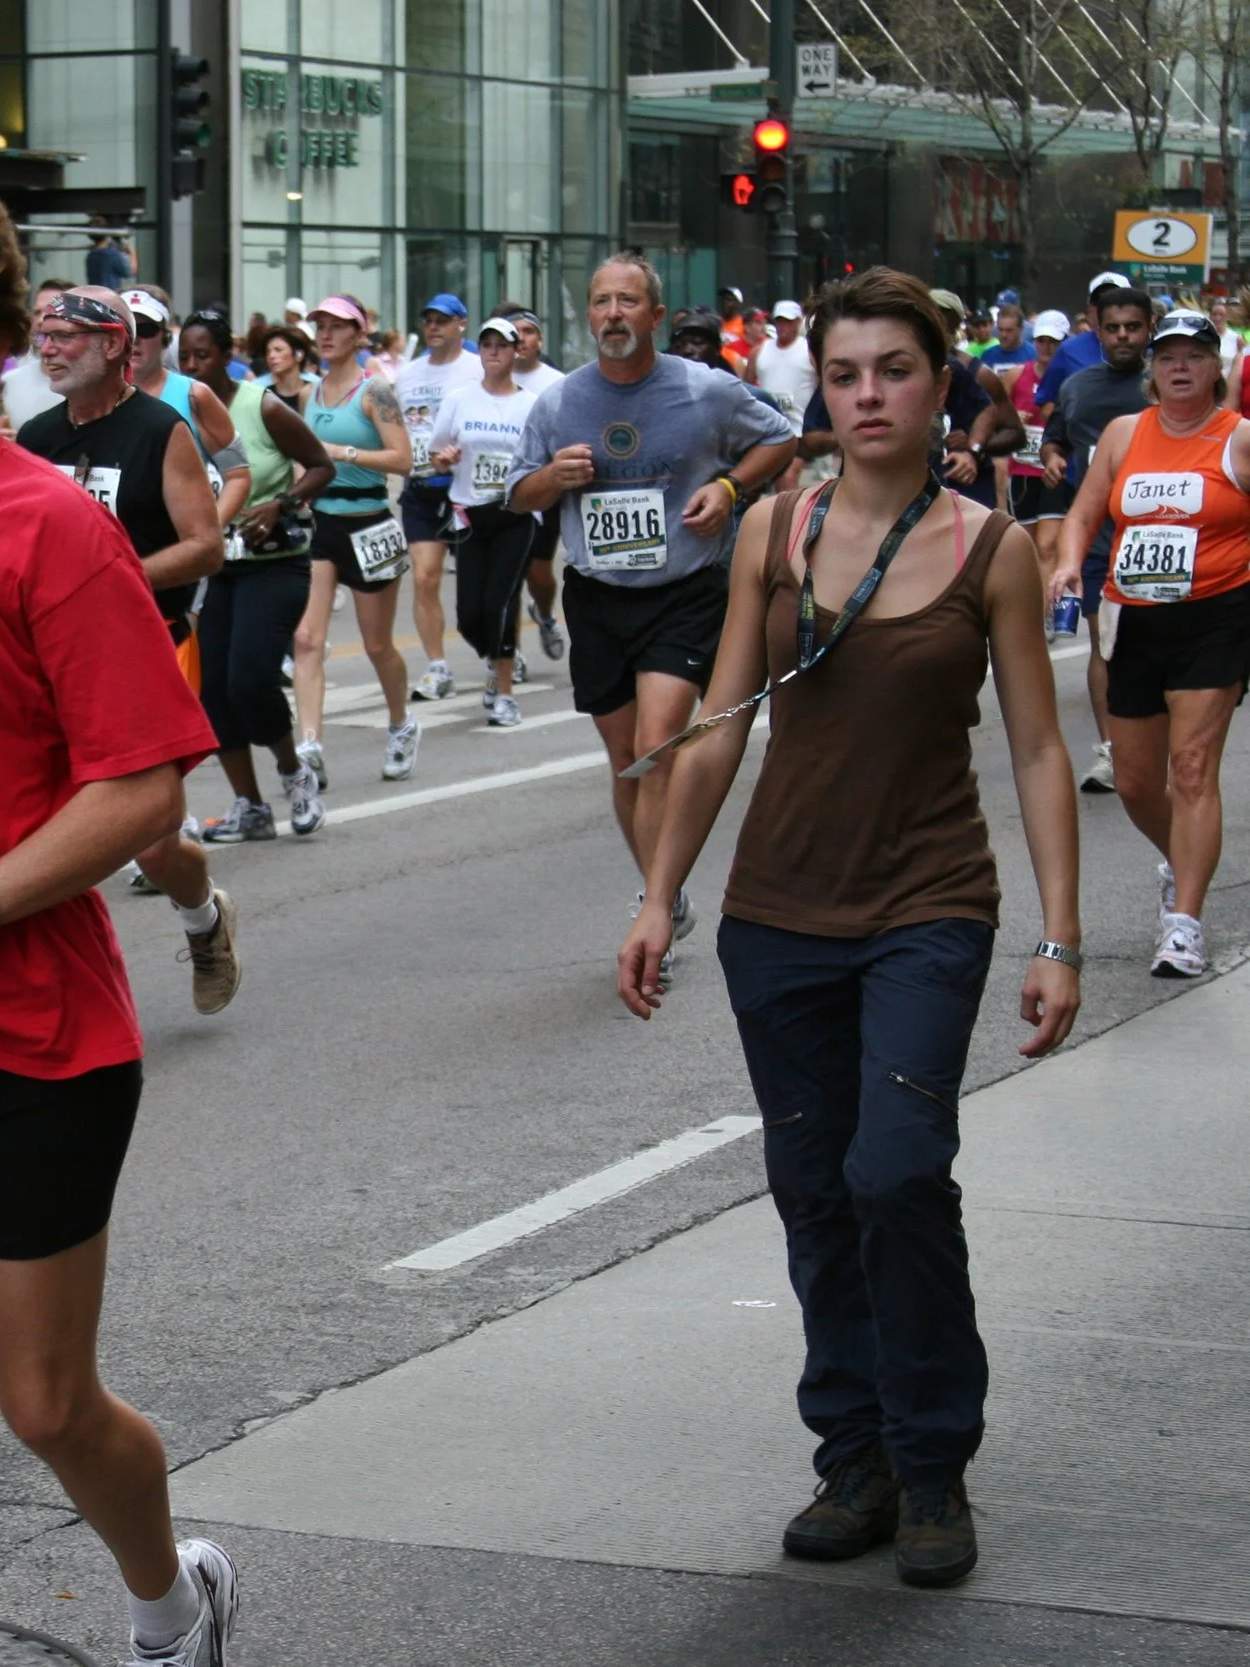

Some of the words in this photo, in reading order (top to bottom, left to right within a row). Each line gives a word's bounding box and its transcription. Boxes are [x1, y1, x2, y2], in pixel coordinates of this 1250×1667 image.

[802, 49, 832, 62] ONE
[803, 63, 832, 77] WAY
[242, 69, 383, 116] STABUCKS
[269, 128, 360, 168] CFFEE
[1152, 222, 1171, 246] 2
[604, 498, 631, 506] LaSalle
[632, 496, 650, 504] Bank
[1128, 480, 1191, 499] Janet
[586, 508, 660, 541] 28916
[1119, 543, 1187, 574] 34381
